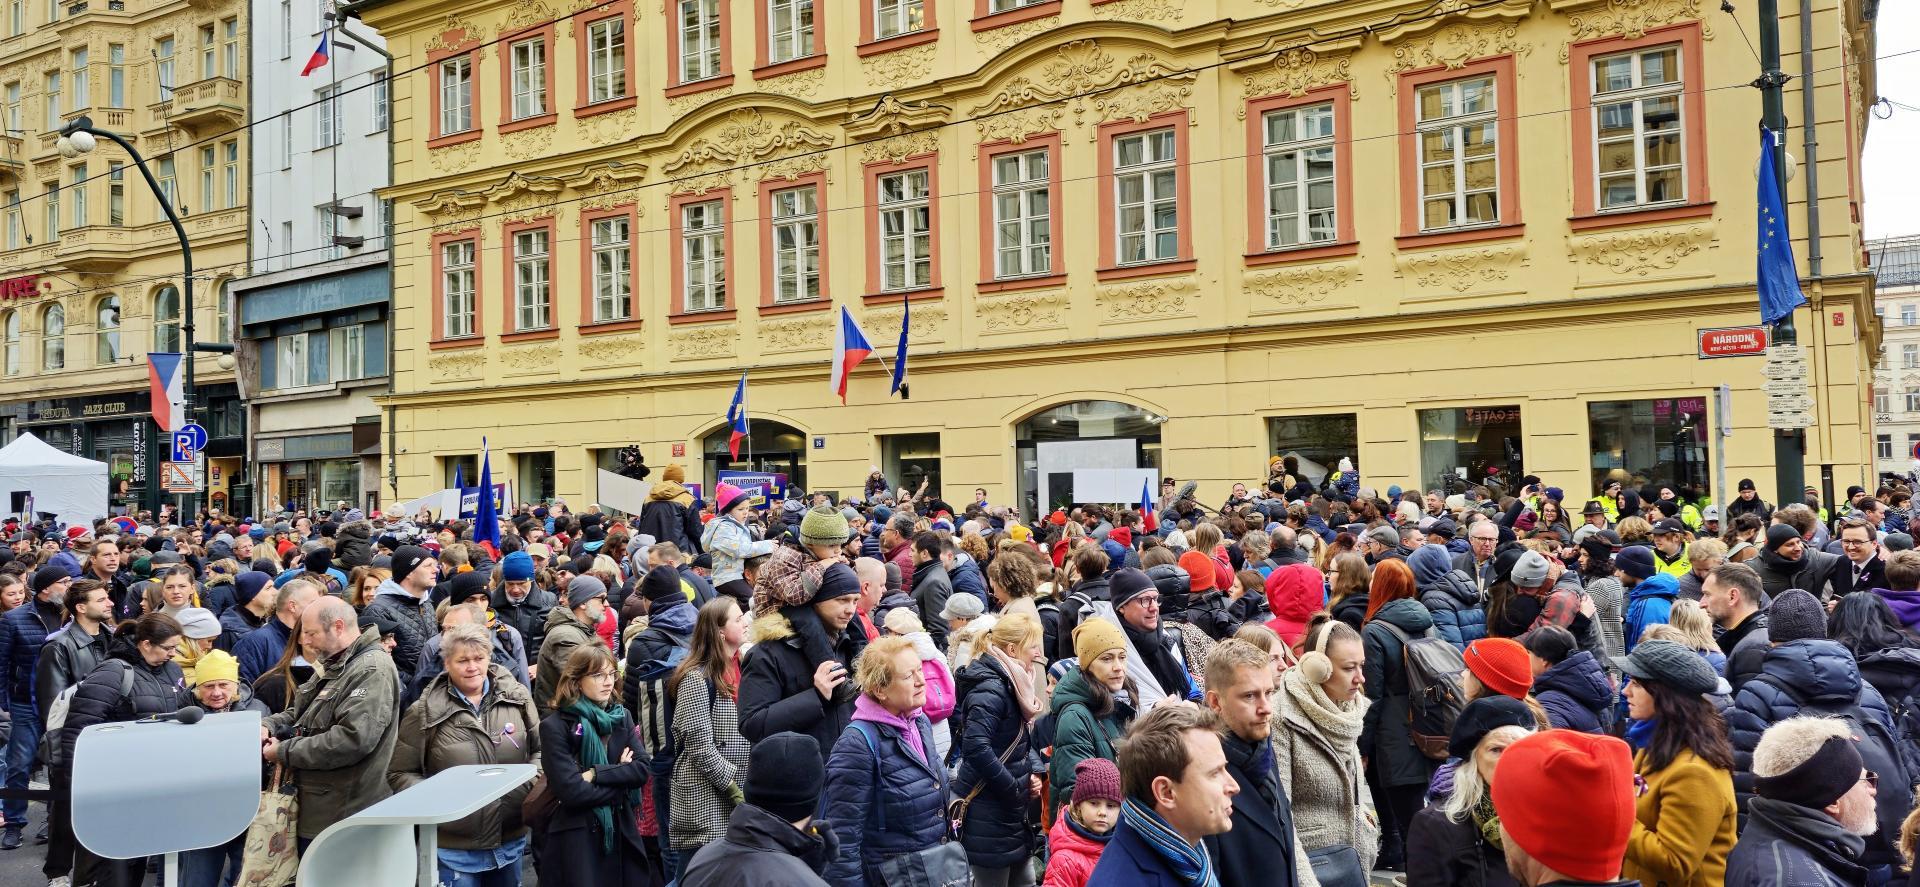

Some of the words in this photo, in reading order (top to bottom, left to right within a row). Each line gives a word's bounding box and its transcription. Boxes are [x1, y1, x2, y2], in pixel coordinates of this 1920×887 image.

[1713, 332, 1754, 345] NÁRODNÍ
[83, 404, 103, 415] JAZZ
[104, 402, 126, 413] CLUB
